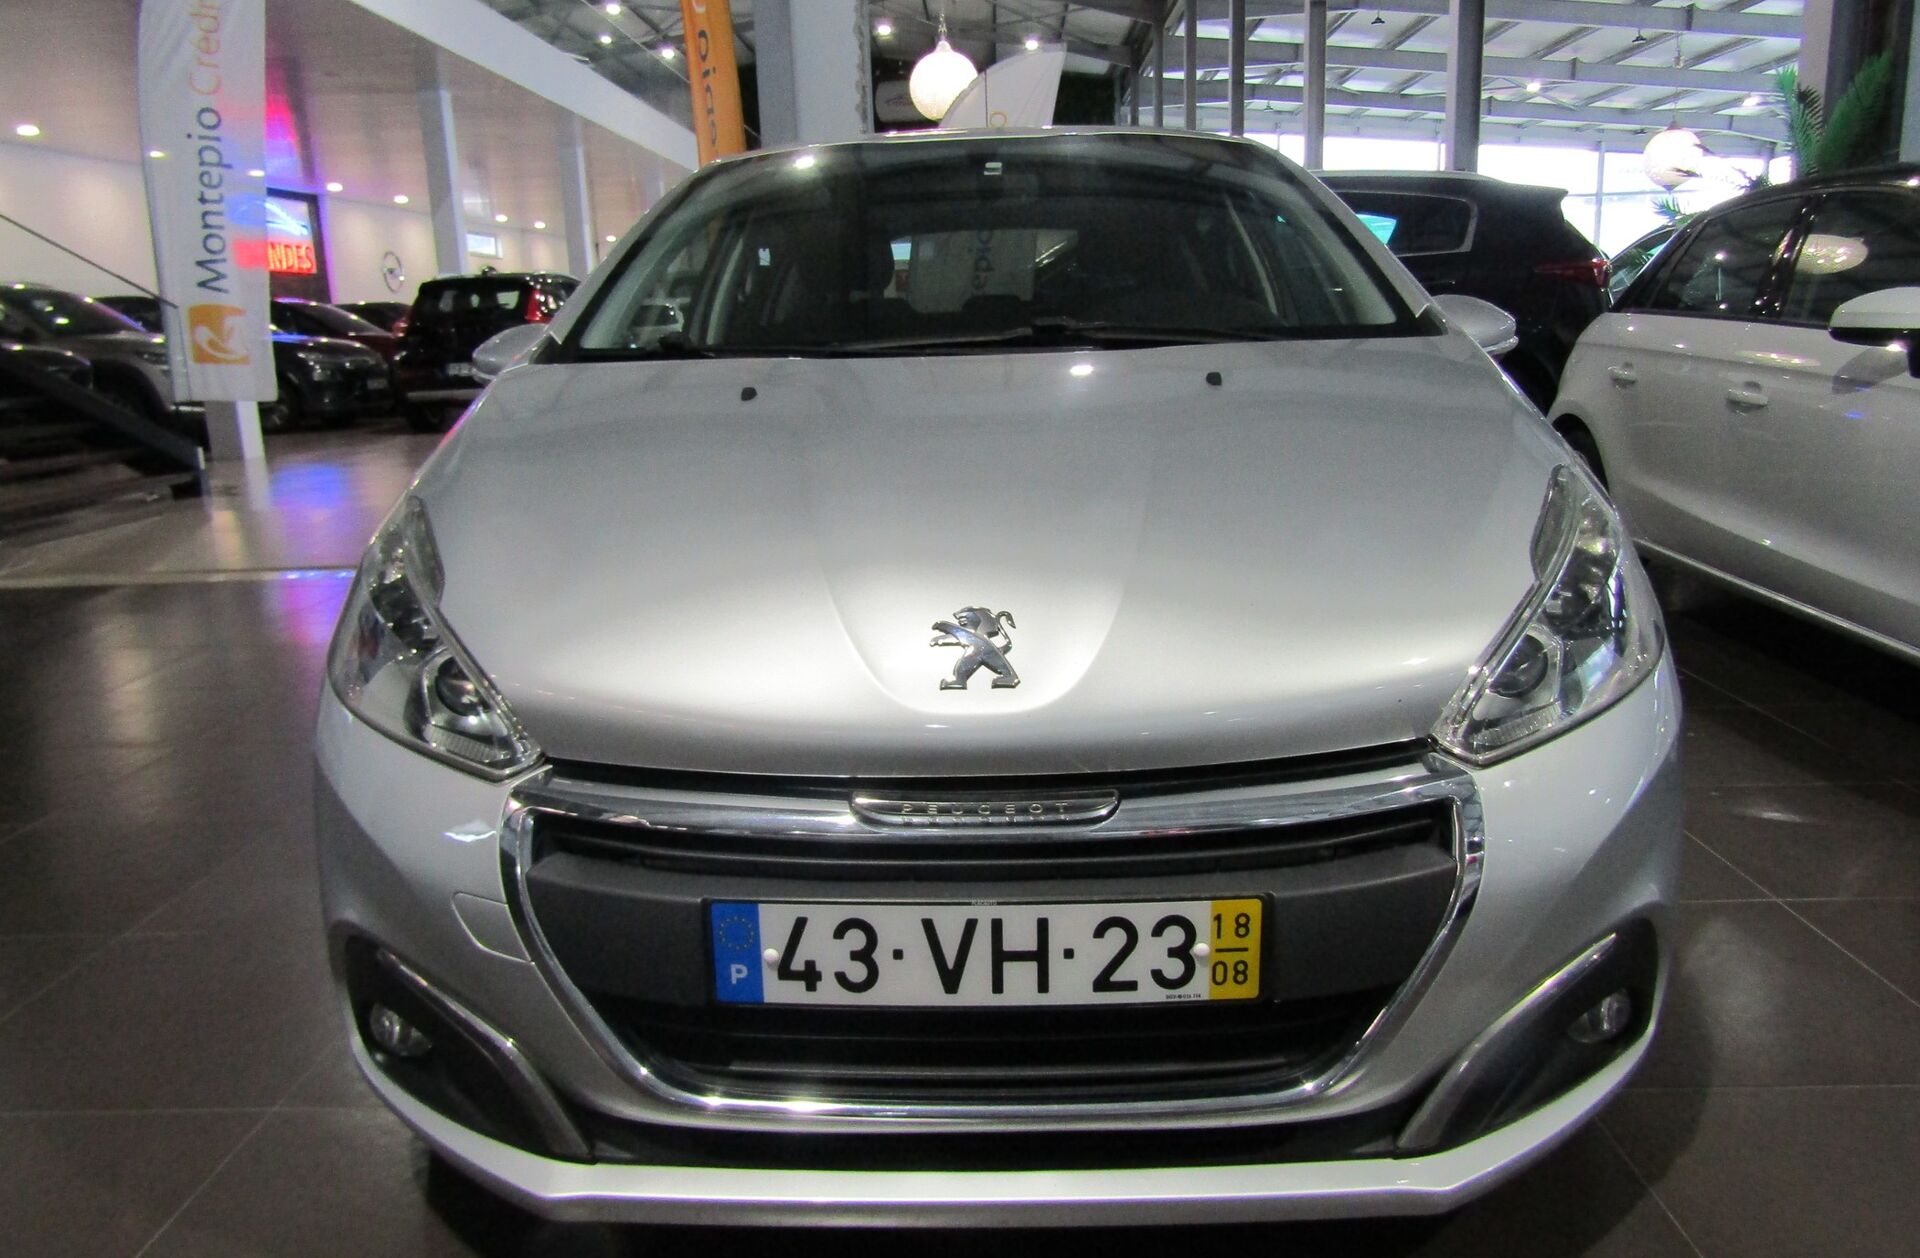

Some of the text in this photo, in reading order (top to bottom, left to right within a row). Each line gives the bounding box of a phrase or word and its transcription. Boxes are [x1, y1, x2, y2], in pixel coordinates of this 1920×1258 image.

[187, 106, 232, 294] Montepio
[901, 802, 1068, 817] PEUGEOT
[1213, 913, 1250, 939] 18
[731, 964, 748, 984] P
[1211, 959, 1249, 985] 08
